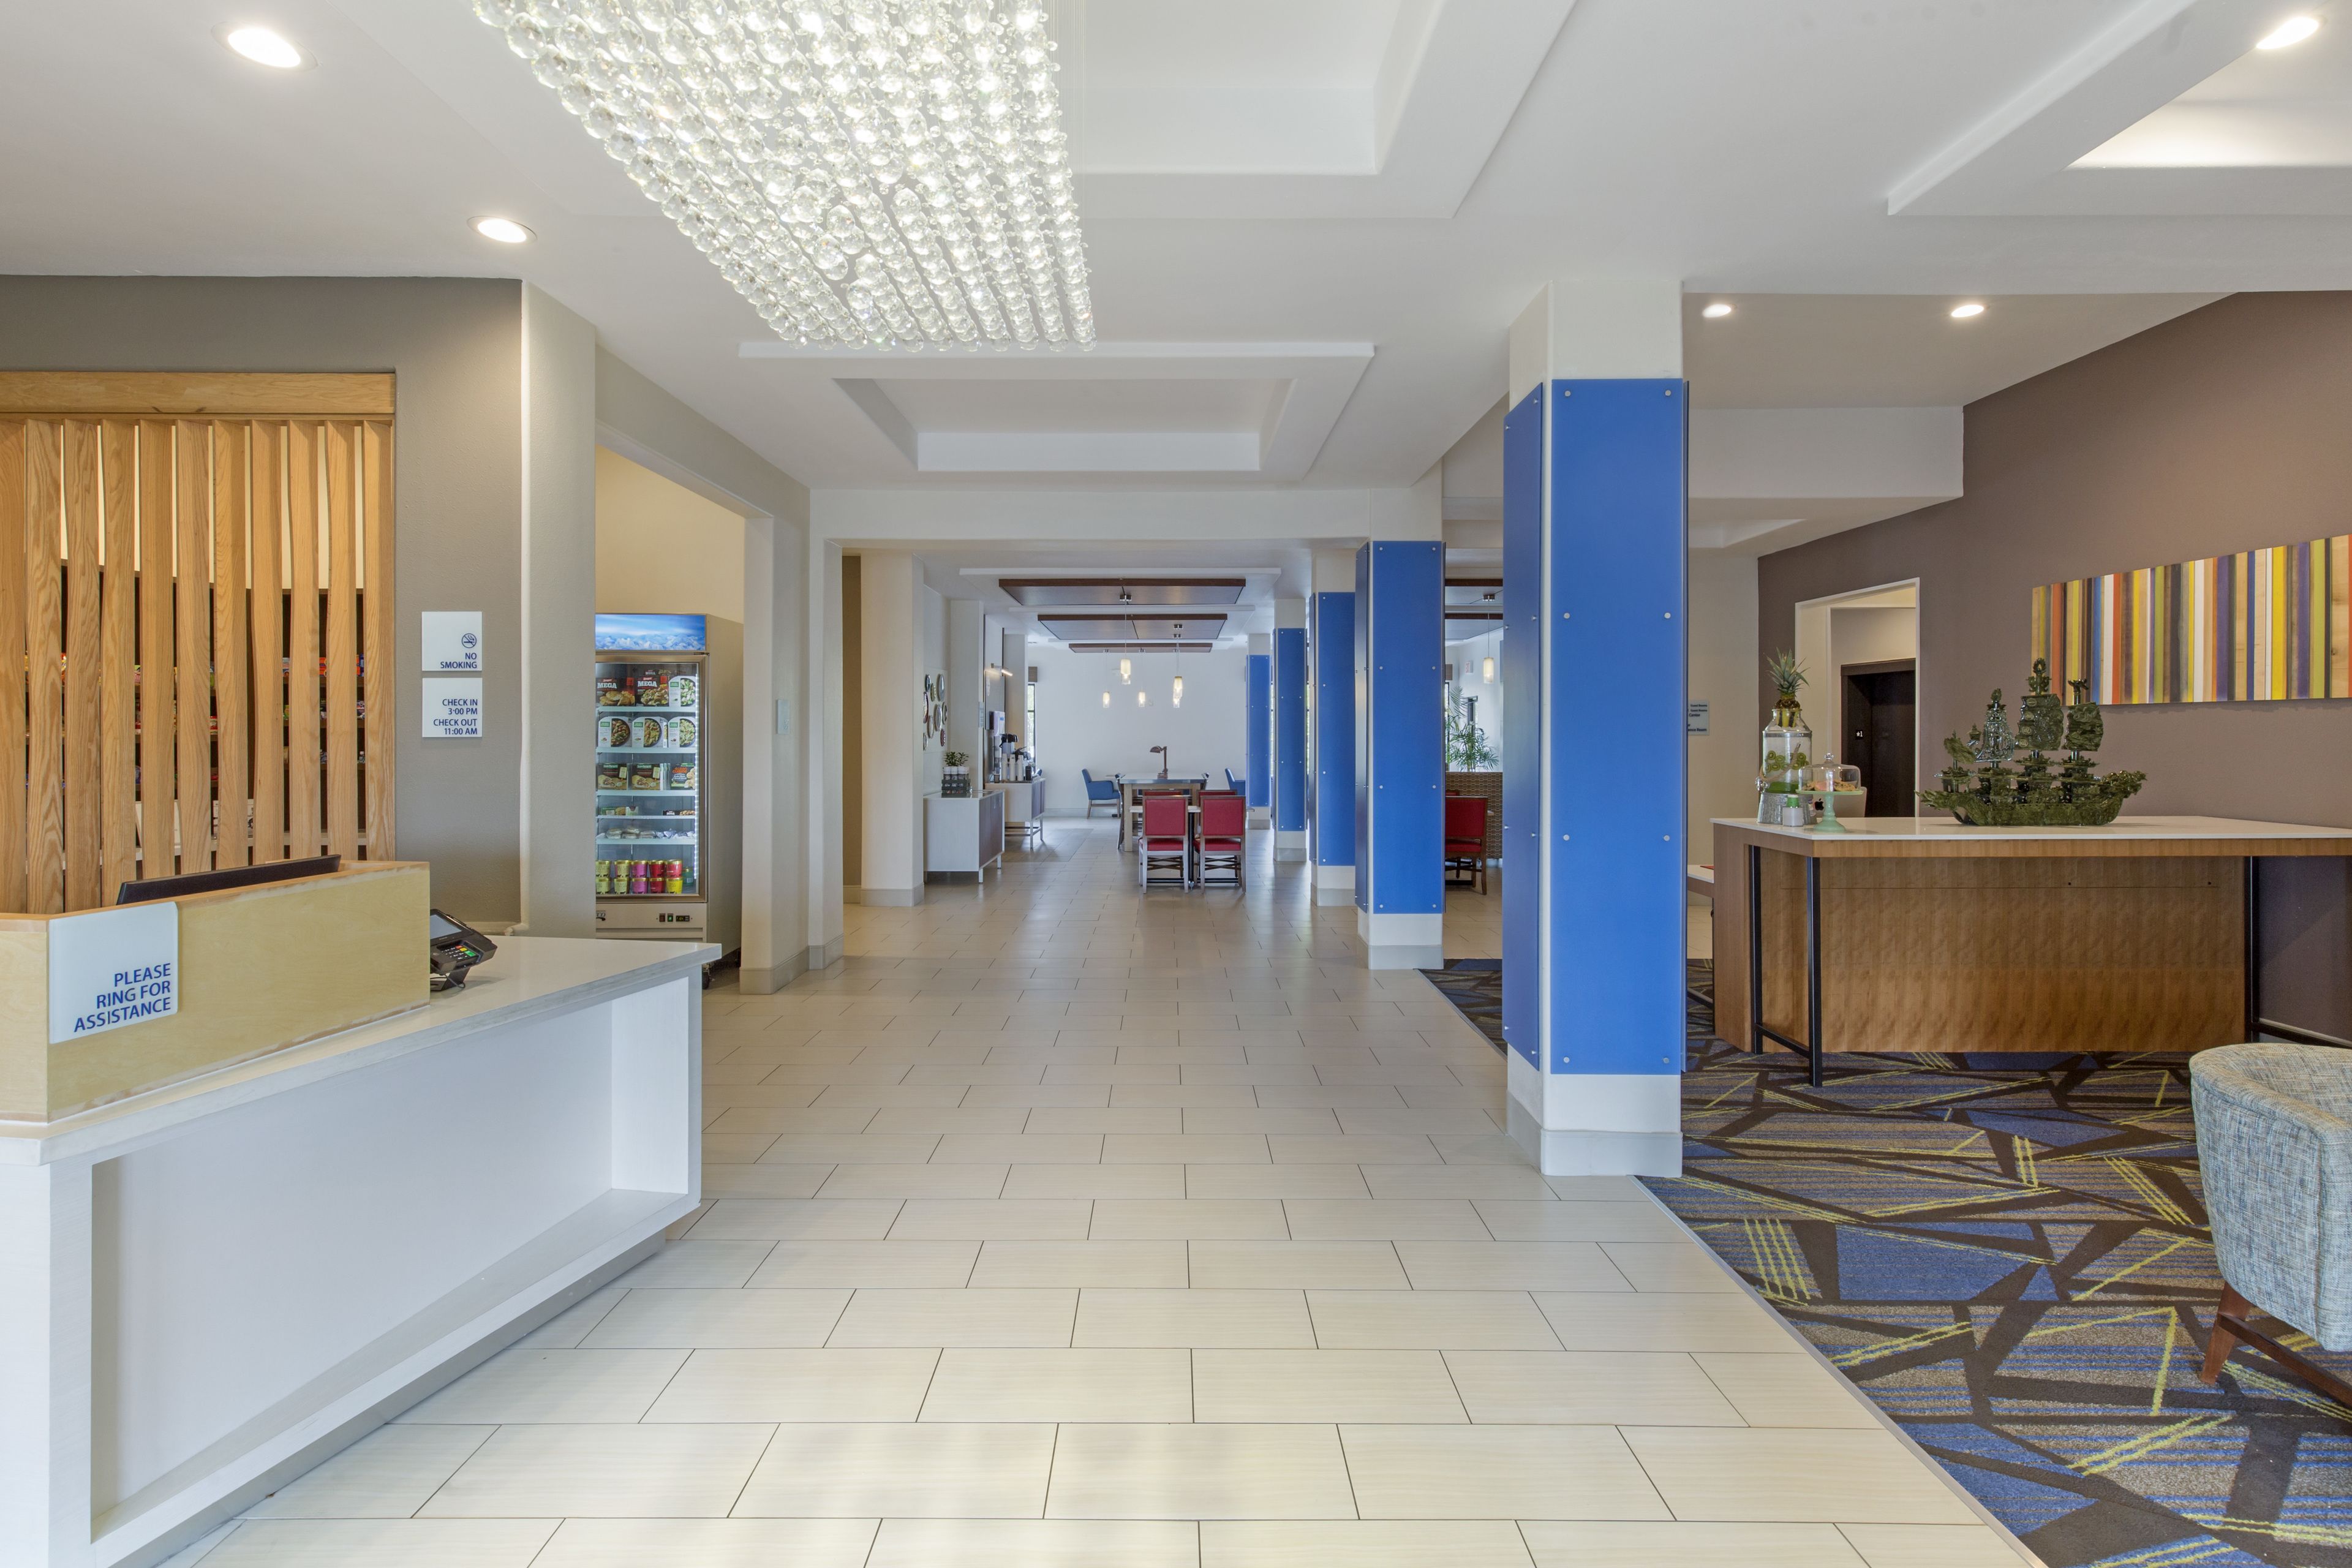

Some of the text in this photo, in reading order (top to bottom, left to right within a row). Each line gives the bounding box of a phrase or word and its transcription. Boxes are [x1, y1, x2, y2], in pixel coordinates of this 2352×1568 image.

[114, 963, 171, 987] PLEASE
[96, 980, 171, 1009] RING FOR
[74, 997, 171, 1033] ASSISTANCE
